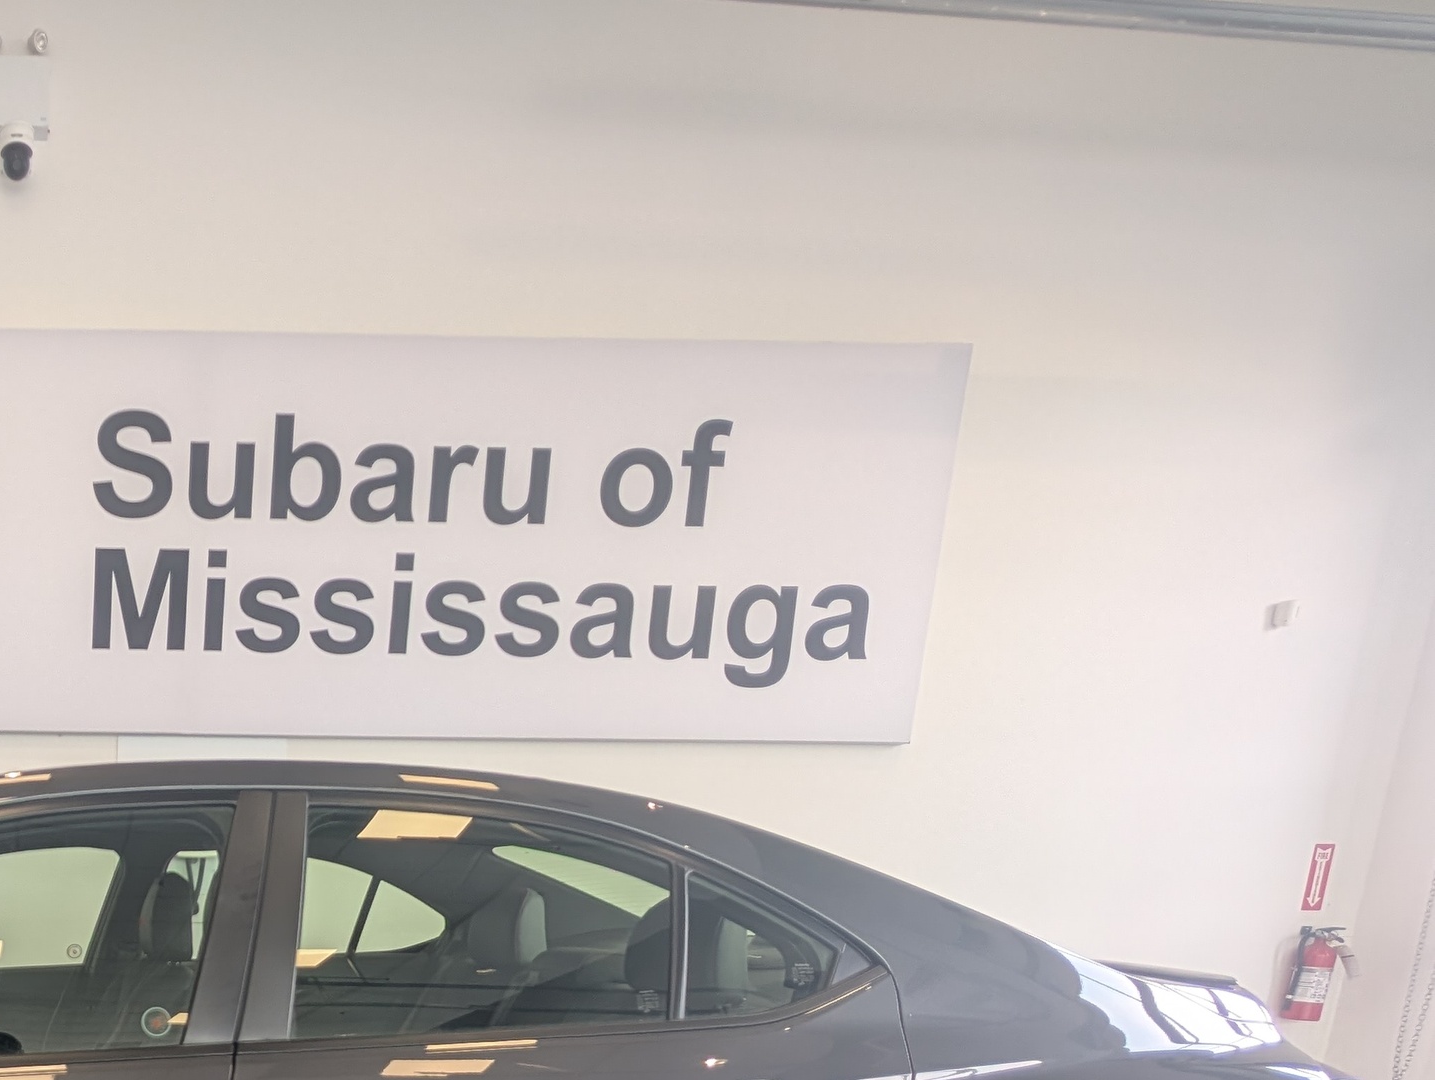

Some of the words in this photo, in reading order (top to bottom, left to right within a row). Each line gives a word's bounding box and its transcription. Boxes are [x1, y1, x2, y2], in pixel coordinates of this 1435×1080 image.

[93, 409, 552, 526] Subaru
[600, 418, 733, 528] of
[91, 547, 870, 689] Mississauga
